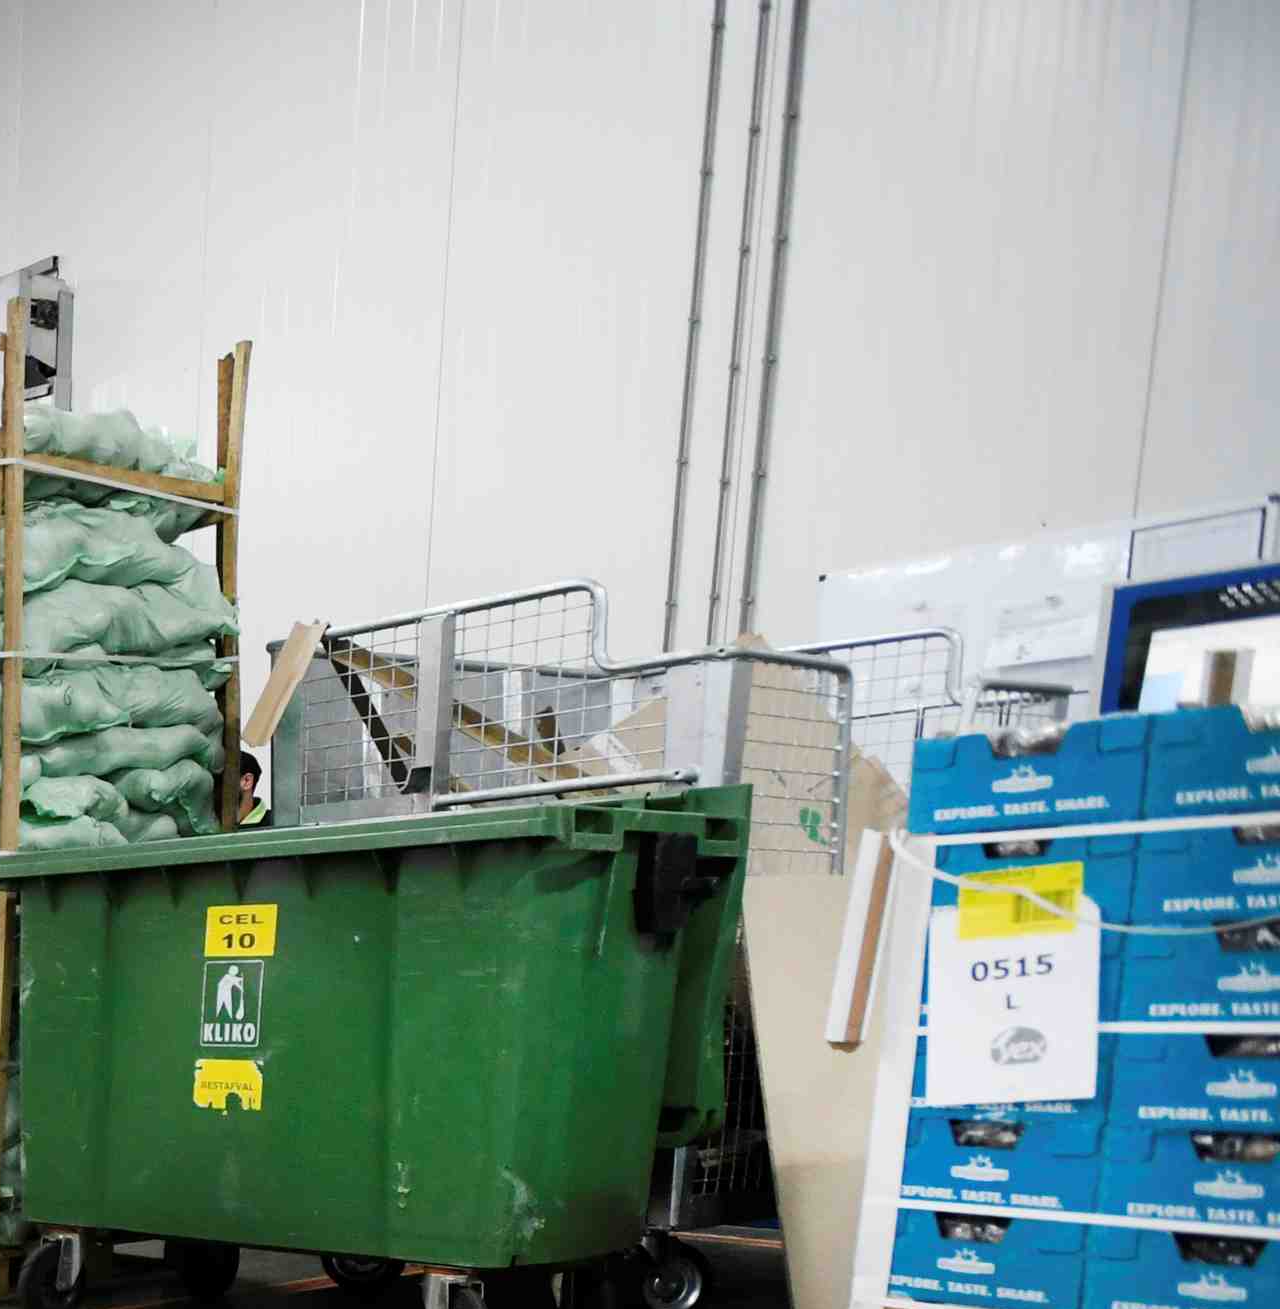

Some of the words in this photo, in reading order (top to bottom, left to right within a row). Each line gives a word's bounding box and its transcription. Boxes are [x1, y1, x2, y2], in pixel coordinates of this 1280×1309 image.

[219, 914, 264, 925] CEL
[222, 933, 256, 949] 10
[971, 953, 1054, 982] 0515
[1006, 994, 1019, 1010] L
[203, 1023, 256, 1043] KLIKO
